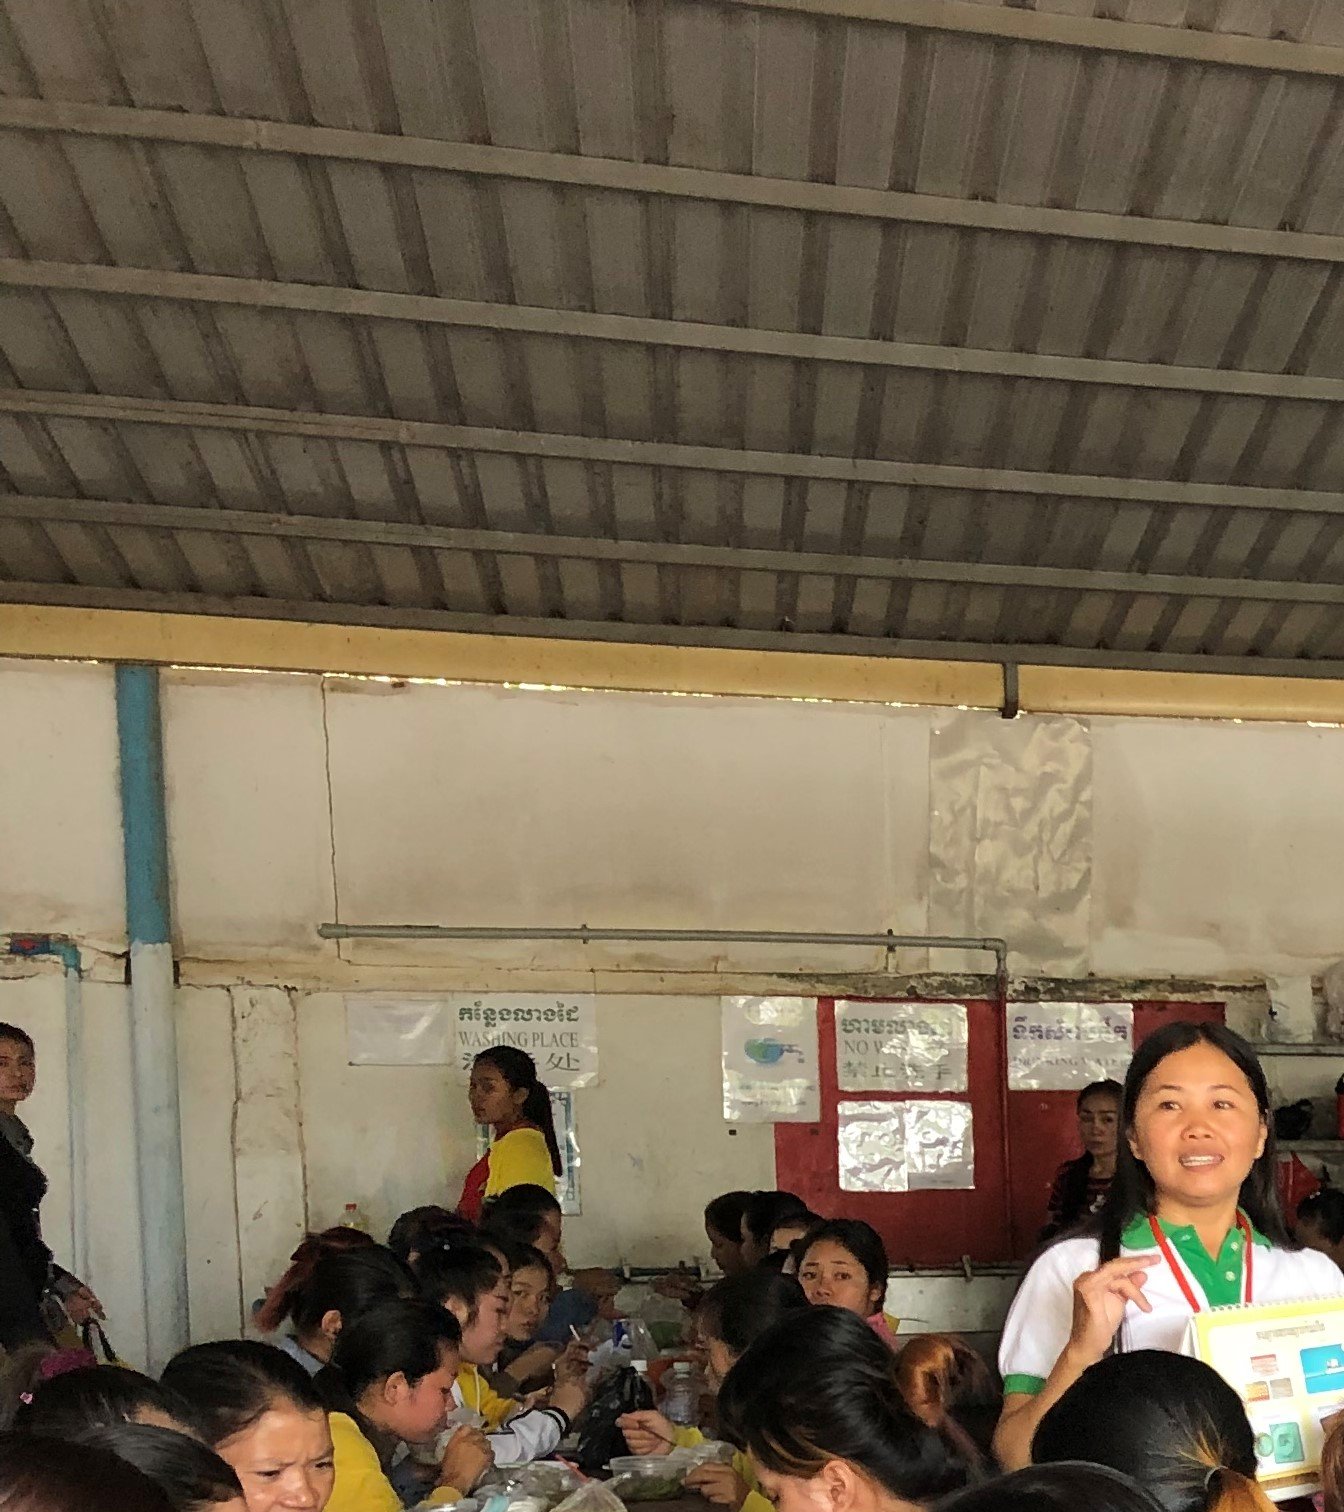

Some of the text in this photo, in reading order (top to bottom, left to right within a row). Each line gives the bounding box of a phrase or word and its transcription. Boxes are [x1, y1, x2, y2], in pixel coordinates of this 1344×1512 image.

[459, 1032, 578, 1048] WASHING PLACE
[844, 1040, 869, 1055] NO
